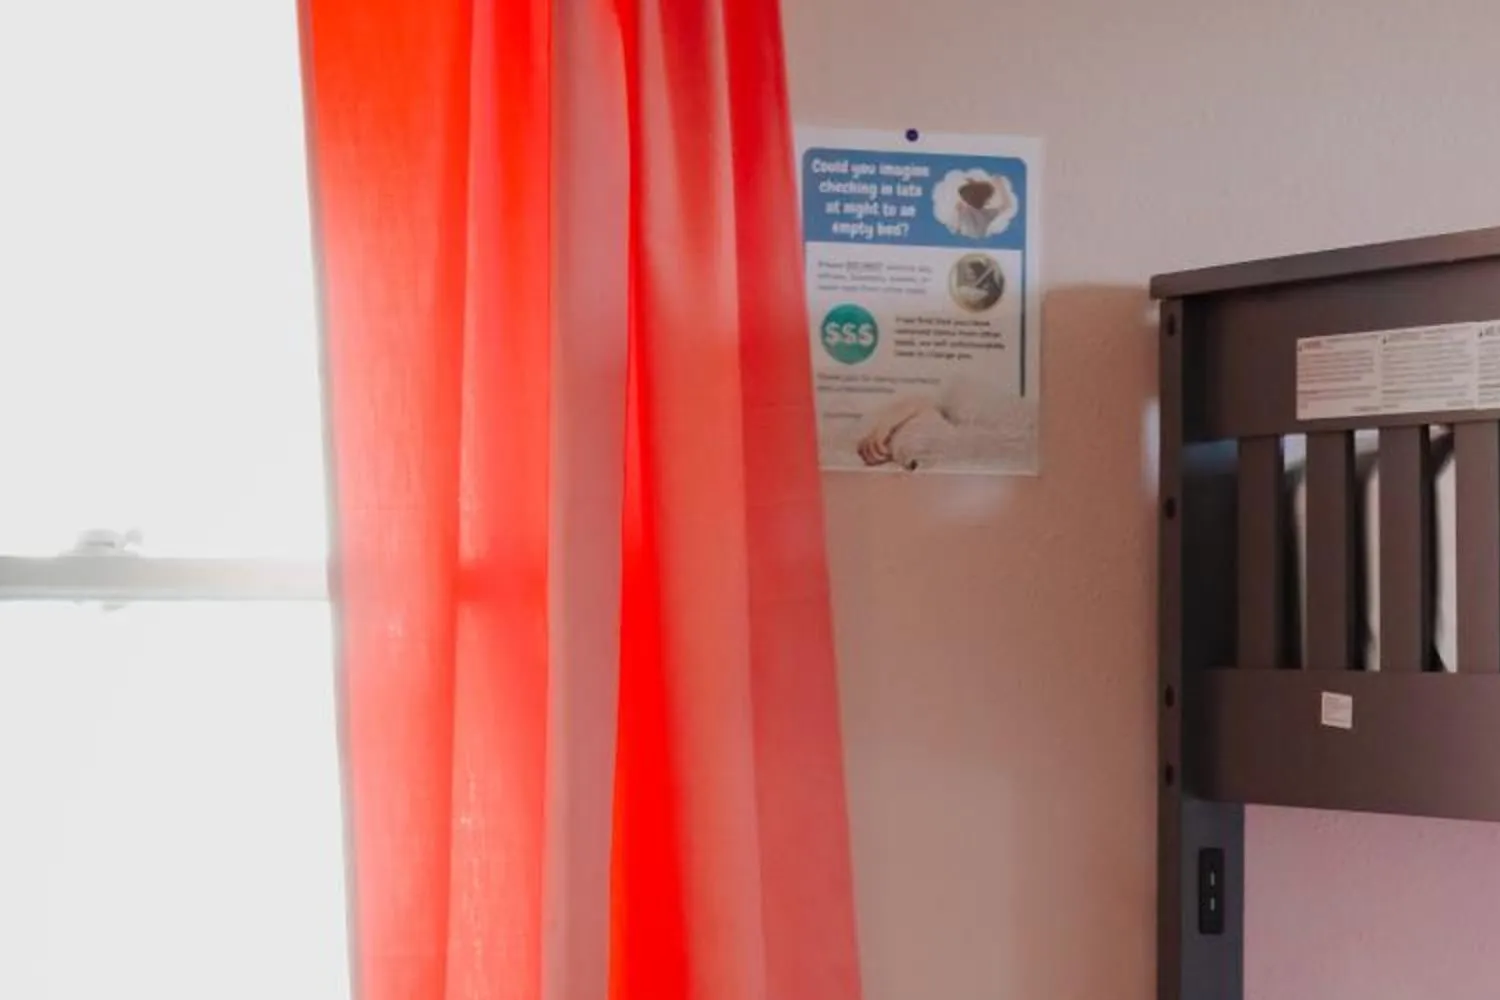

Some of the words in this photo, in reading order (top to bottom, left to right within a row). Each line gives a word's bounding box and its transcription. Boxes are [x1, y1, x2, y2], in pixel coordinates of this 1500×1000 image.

[811, 158, 849, 174] Could
[851, 163, 877, 179] you
[879, 163, 930, 182] imagine
[819, 179, 878, 201] checking
[881, 183, 893, 196] in
[896, 181, 923, 197] late
[825, 201, 841, 215] at
[843, 201, 880, 219] night
[882, 203, 898, 217] to
[832, 221, 874, 240] empty
[877, 222, 910, 237] bed?
